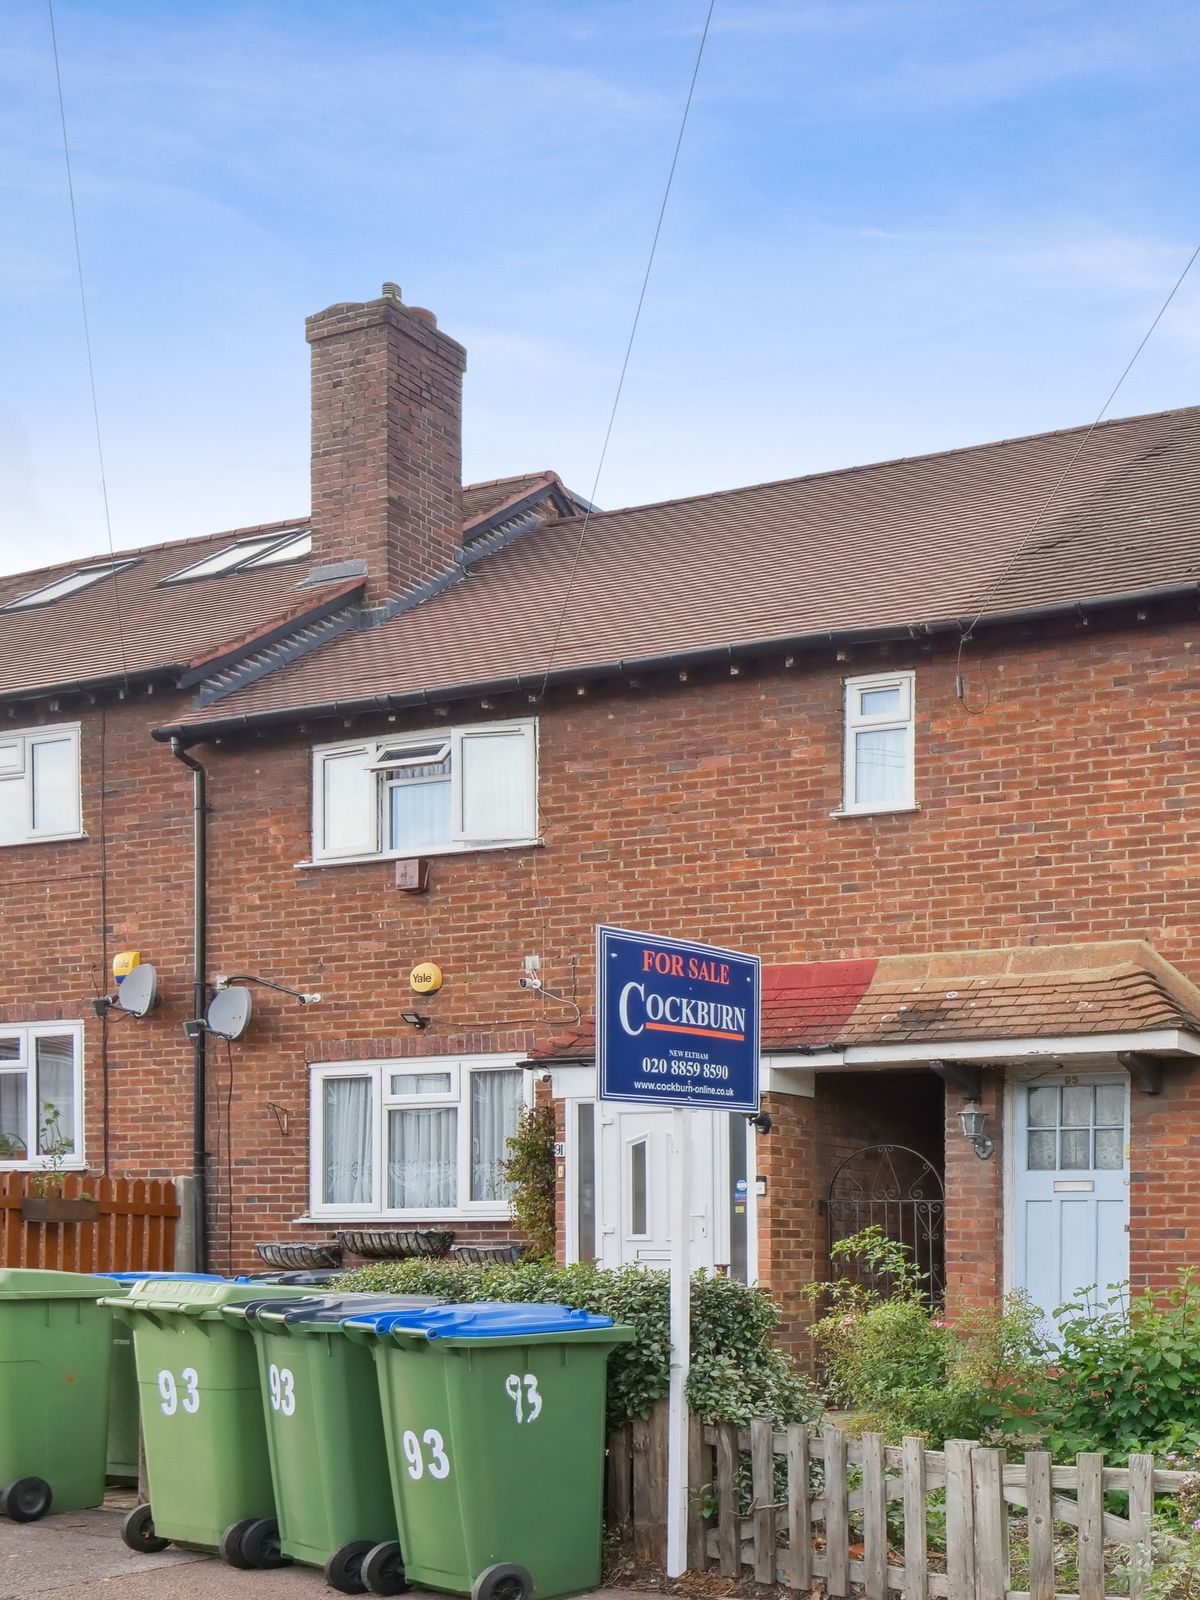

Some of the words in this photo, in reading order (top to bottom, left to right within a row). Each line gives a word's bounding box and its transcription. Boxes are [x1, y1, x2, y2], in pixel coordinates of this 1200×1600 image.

[412, 973, 432, 983] Yale
[642, 949, 685, 977] FOR
[688, 957, 730, 985] SALE
[642, 1057, 668, 1074] 020
[670, 1059, 701, 1077] 8859
[703, 1063, 729, 1080] 8590
[669, 1049, 684, 1057] NEW
[684, 1051, 709, 1060] ELTHAM
[633, 1080, 734, 1097] www.cockburn-online.co.uk
[158, 1367, 200, 1416] 93
[269, 1363, 296, 1416] 93
[505, 1373, 543, 1424] 93
[403, 1428, 450, 1480] 93
